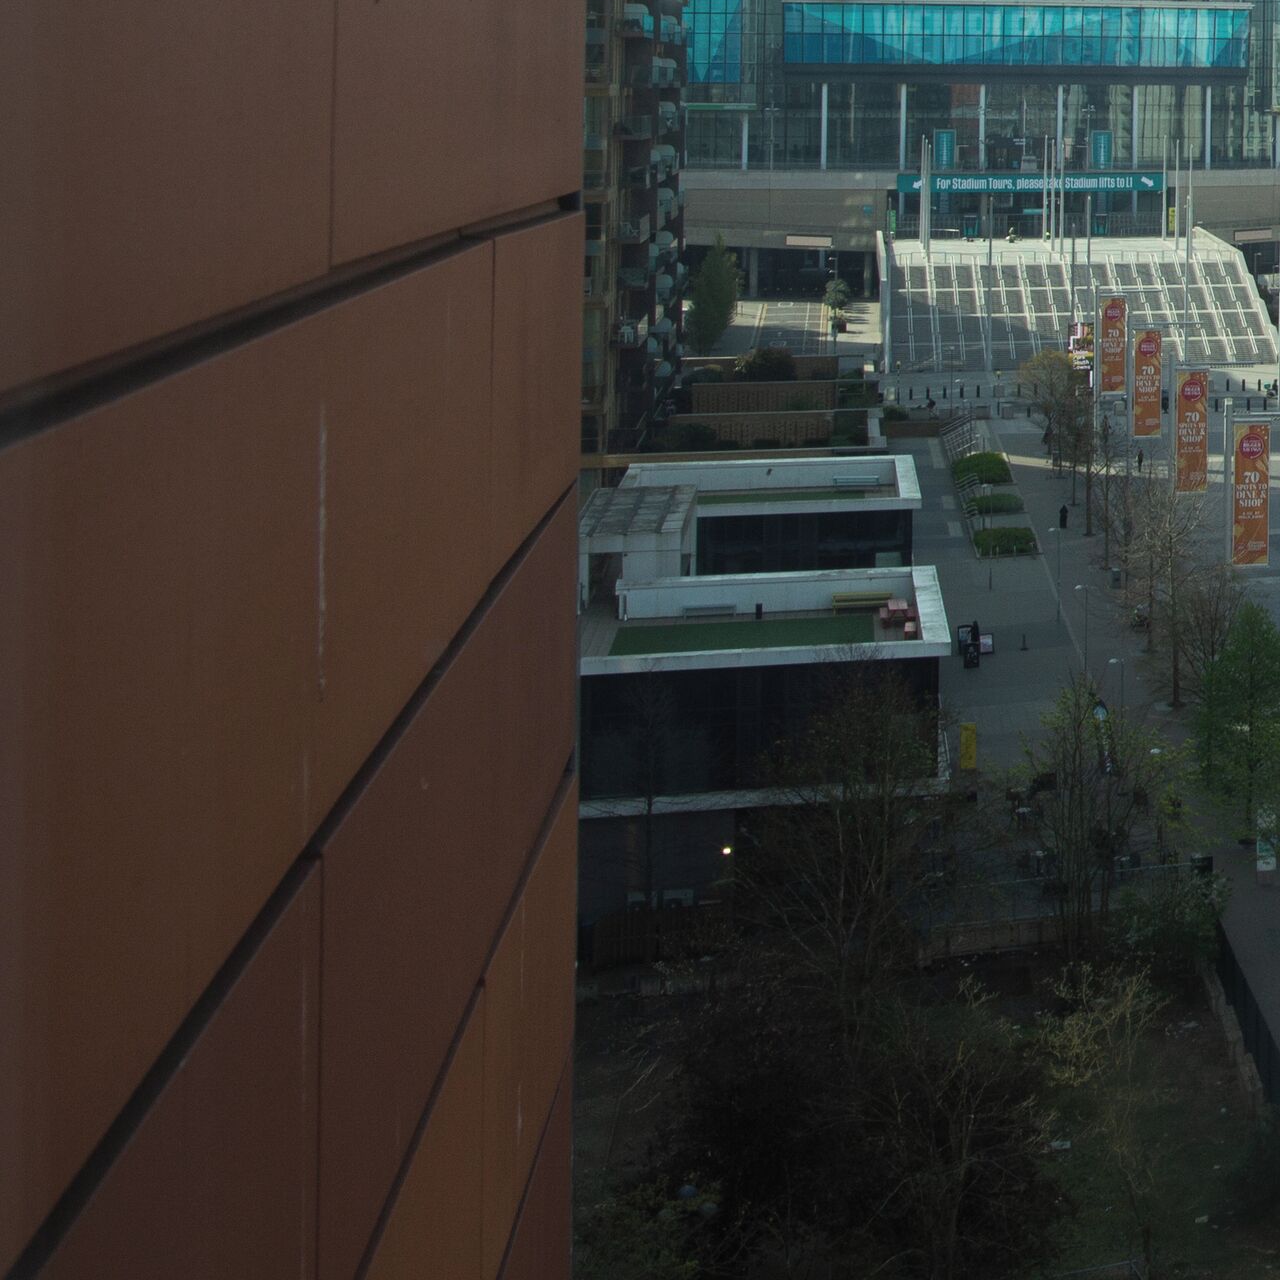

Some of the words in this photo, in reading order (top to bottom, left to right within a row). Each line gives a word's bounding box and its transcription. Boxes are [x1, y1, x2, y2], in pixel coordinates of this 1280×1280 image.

[936, 178, 951, 190] For
[952, 178, 987, 190] Stadium
[988, 178, 1015, 190] Tours,
[1016, 177, 1044, 190] please
[1065, 177, 1098, 189] Stadium
[1099, 176, 1116, 188] lifts
[1116, 177, 1125, 188] to
